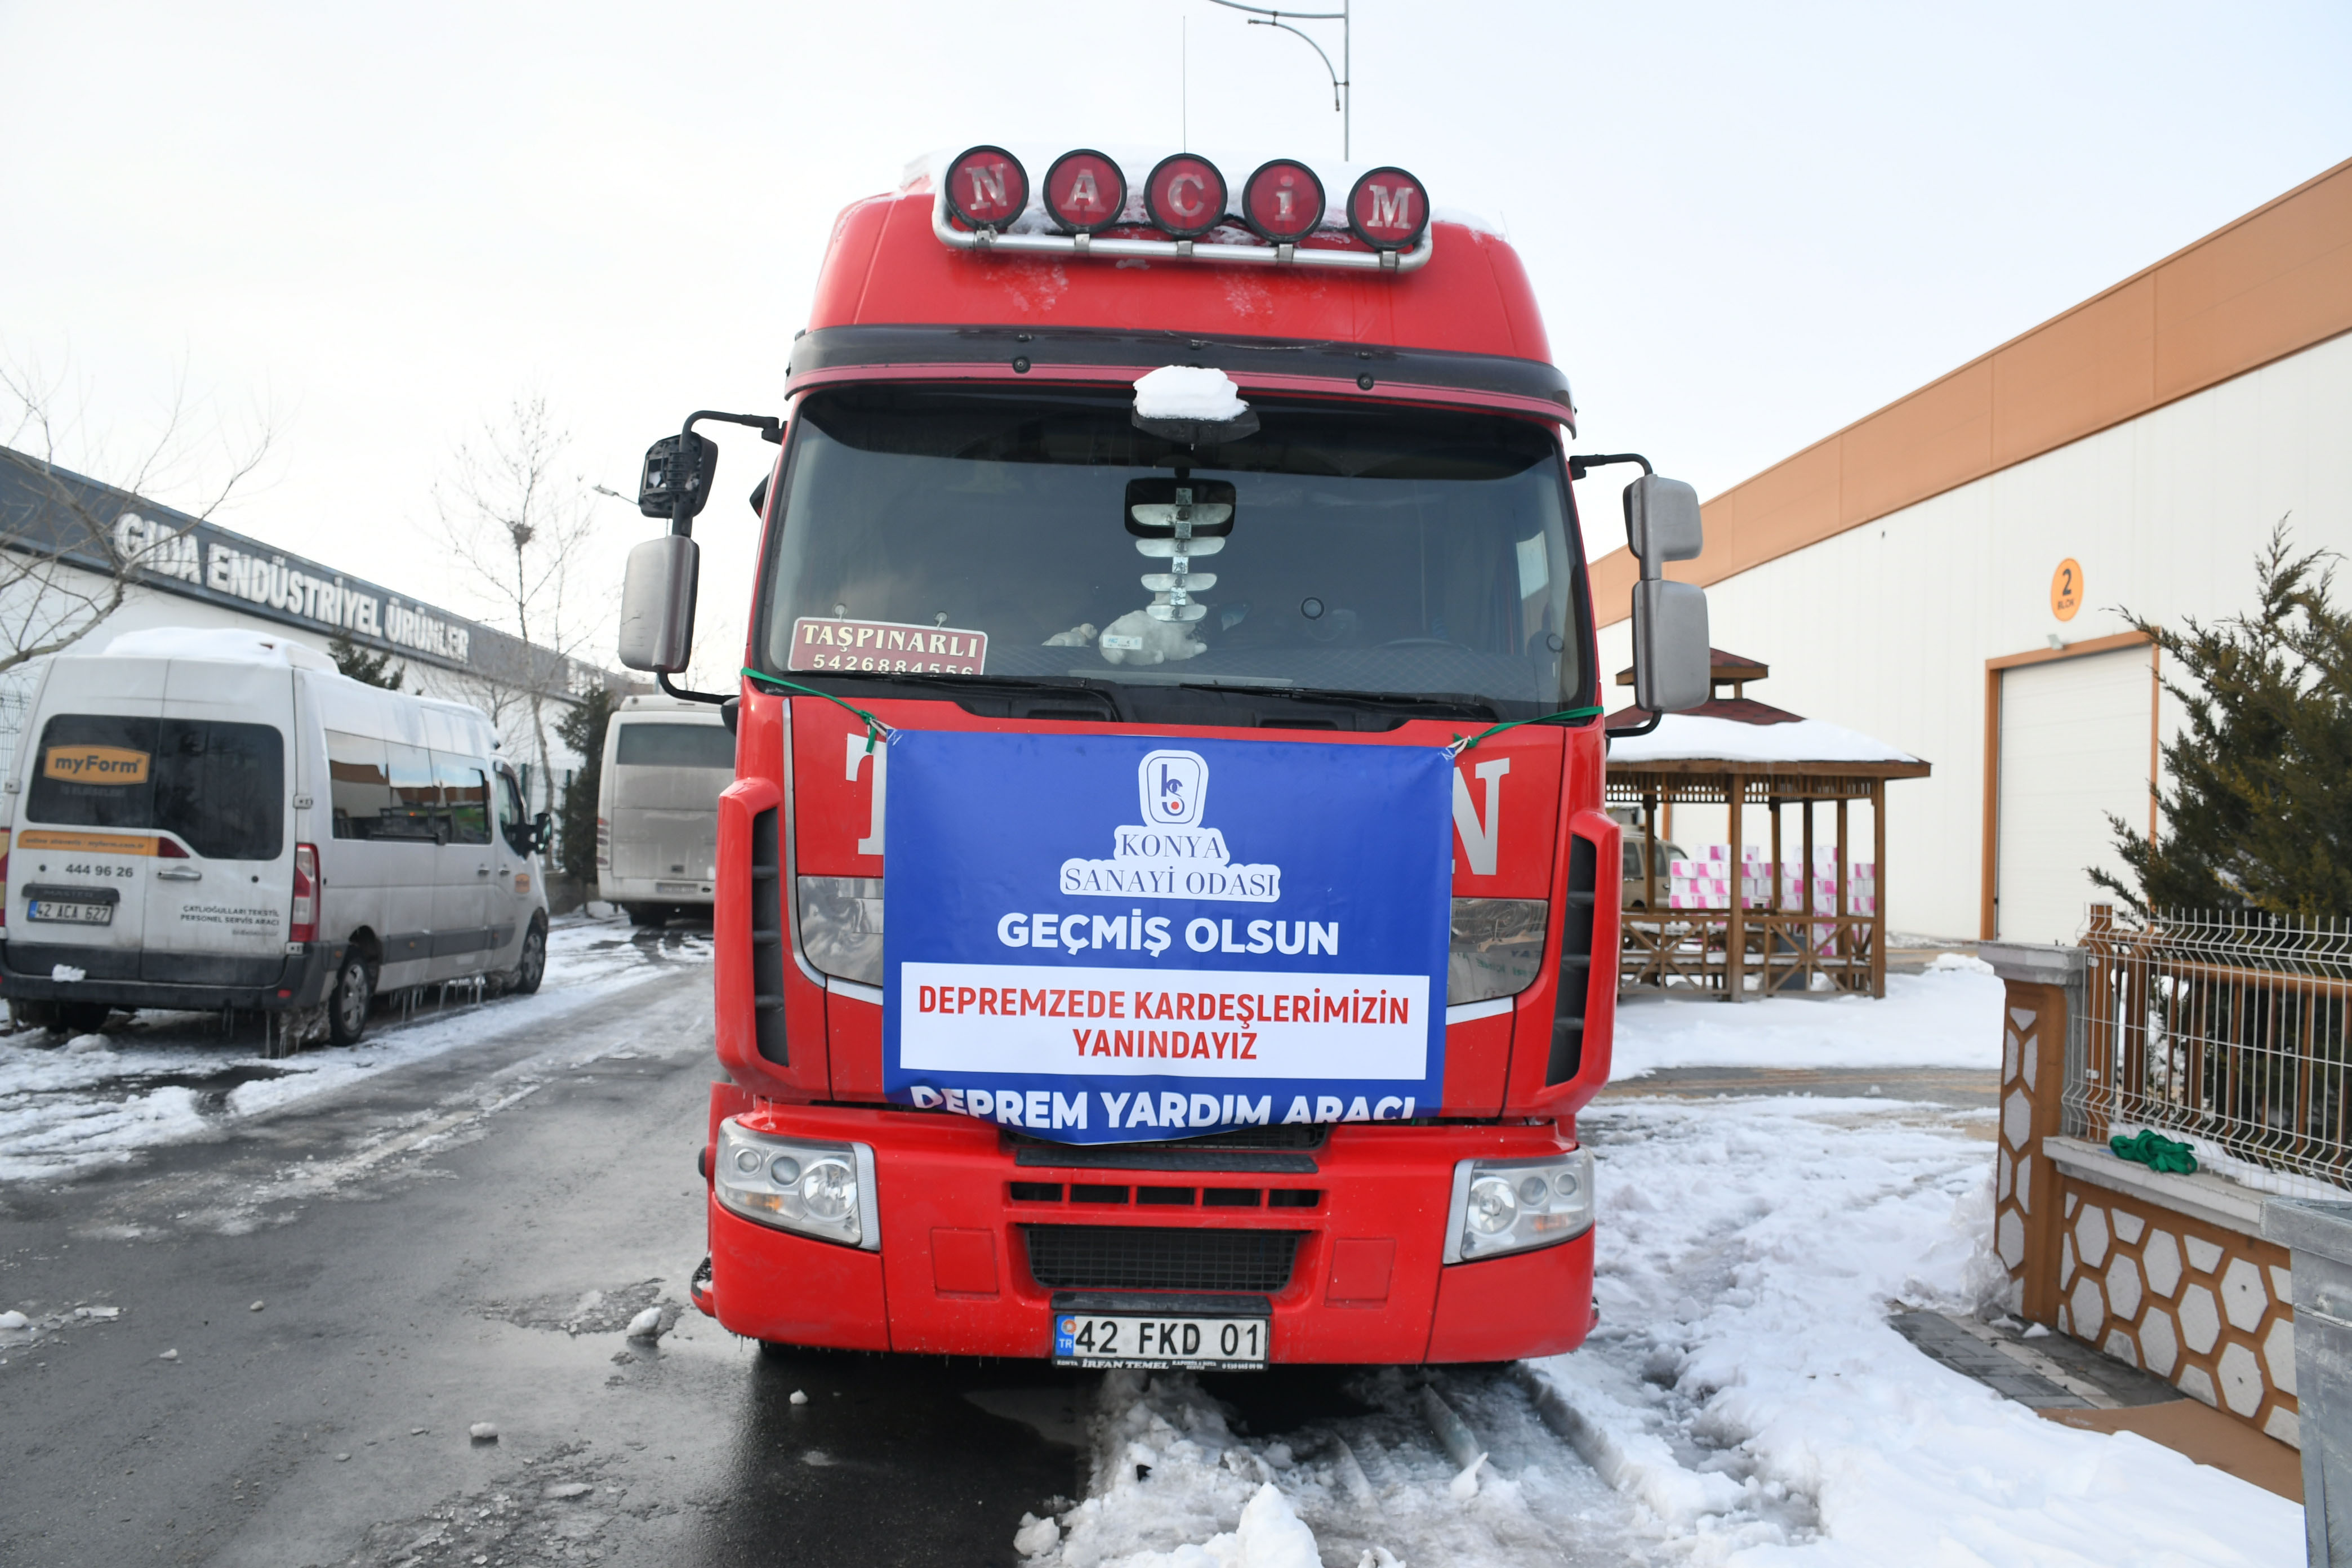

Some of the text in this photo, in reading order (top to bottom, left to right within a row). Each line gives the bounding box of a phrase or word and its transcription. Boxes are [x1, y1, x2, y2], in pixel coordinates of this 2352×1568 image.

[2062, 568, 2072, 596] 2
[206, 542, 382, 638] ENDÜSTRİYEL
[384, 596, 470, 663] ÜRÜNLER
[803, 624, 978, 658] TAŞPINARLI
[1120, 834, 1223, 859] KONYA
[66, 863, 133, 878] 444 96 26
[1064, 866, 1276, 897] SANAYİ ODASI
[37, 903, 51, 917] 42
[57, 905, 78, 919] ACA
[180, 914, 222, 923] PERSONEL
[225, 916, 253, 925] SERVİS
[997, 908, 1339, 958] GEÇMİŞ OLSUN
[919, 985, 1409, 1029] DEPREMZEDE KARDEŞLERİMİZİN
[1072, 1028, 1258, 1060] YANINDAYIZ
[910, 1085, 1416, 1130] DEPREM YARDIM ARACI
[1059, 1338, 1073, 1349] TR
[1075, 1320, 1258, 1356] 42 FKD 01
[1081, 1358, 1124, 1369] İRFAN
[1125, 1360, 1170, 1370] TEMEL
